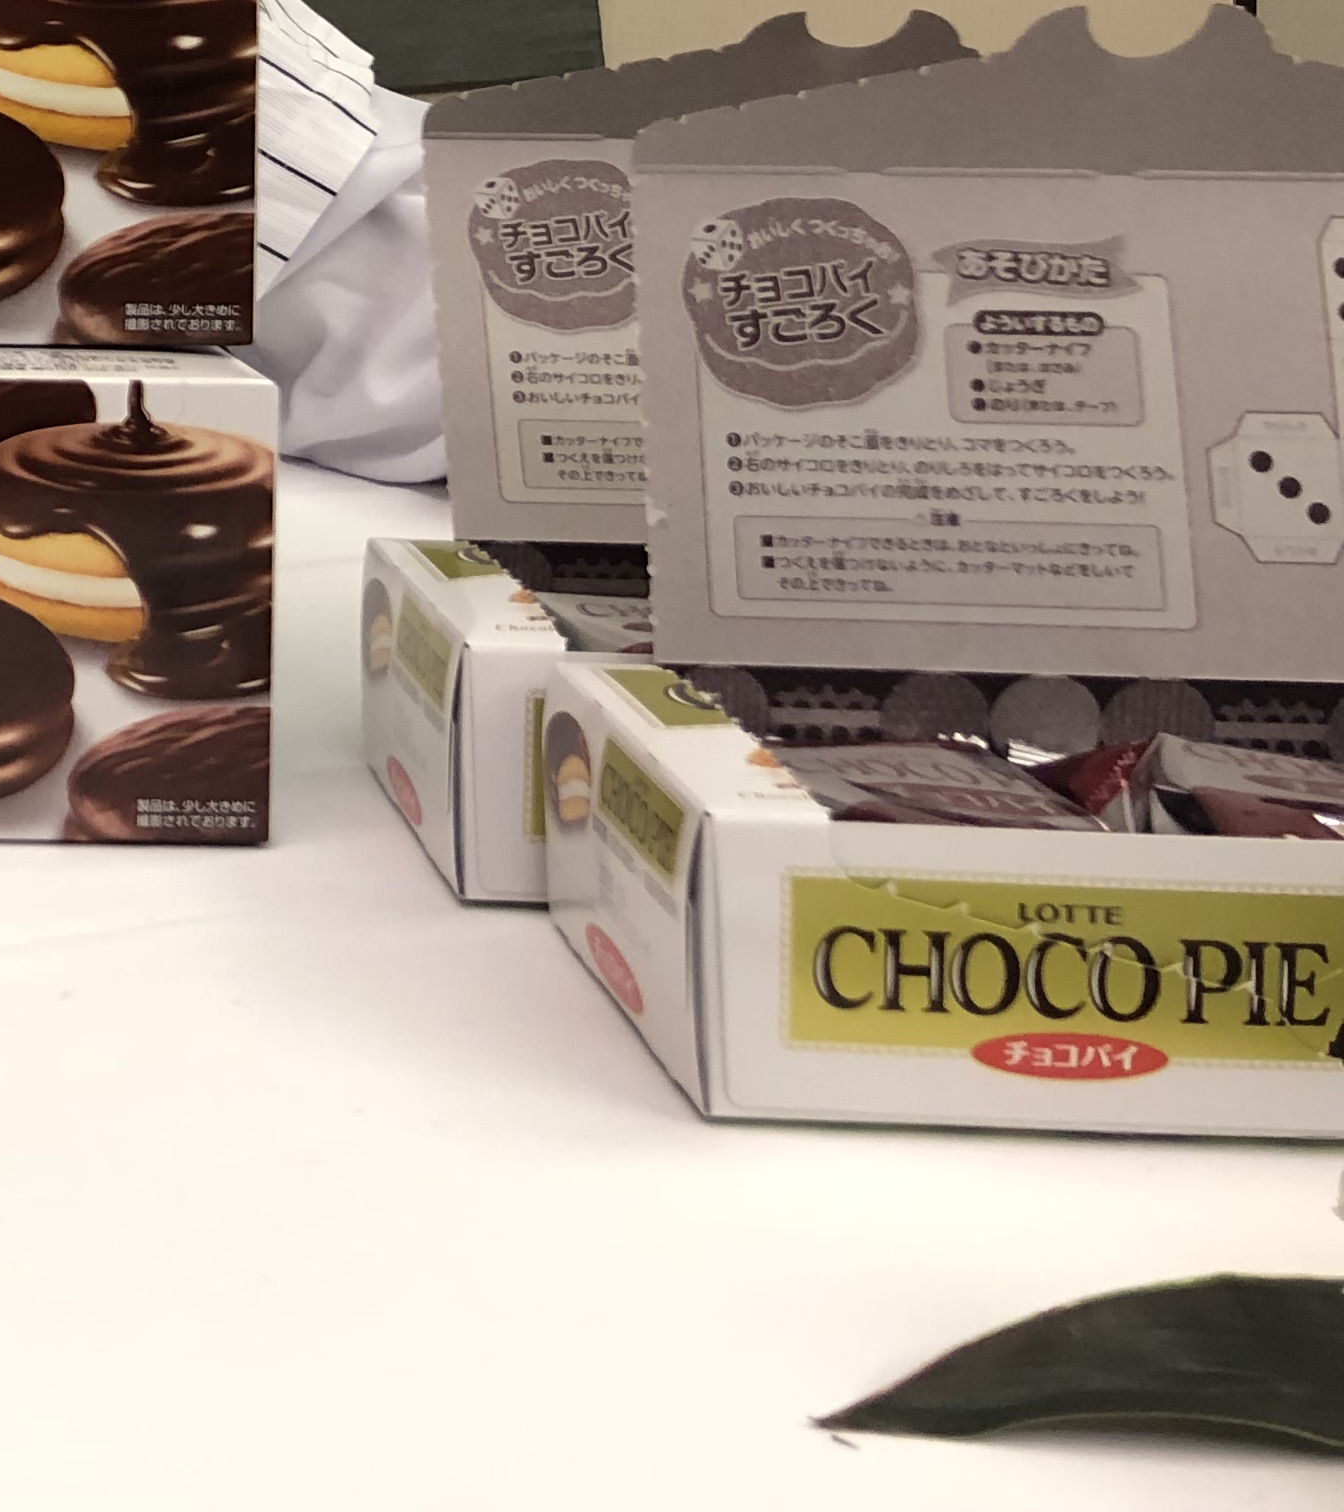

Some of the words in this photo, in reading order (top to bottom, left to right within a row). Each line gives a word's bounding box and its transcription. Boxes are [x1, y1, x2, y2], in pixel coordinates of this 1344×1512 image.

[499, 209, 631, 250] チョコパイ
[506, 242, 636, 285] すごろく
[718, 257, 877, 310] チョコパイ
[957, 246, 1111, 288] あそびかた
[725, 293, 886, 351] すごろく
[1016, 901, 1123, 926] LOTTE
[813, 925, 1161, 1022] CHOCO
[1180, 938, 1331, 1027] PIE
[1003, 1040, 1140, 1072] チョコパイ
